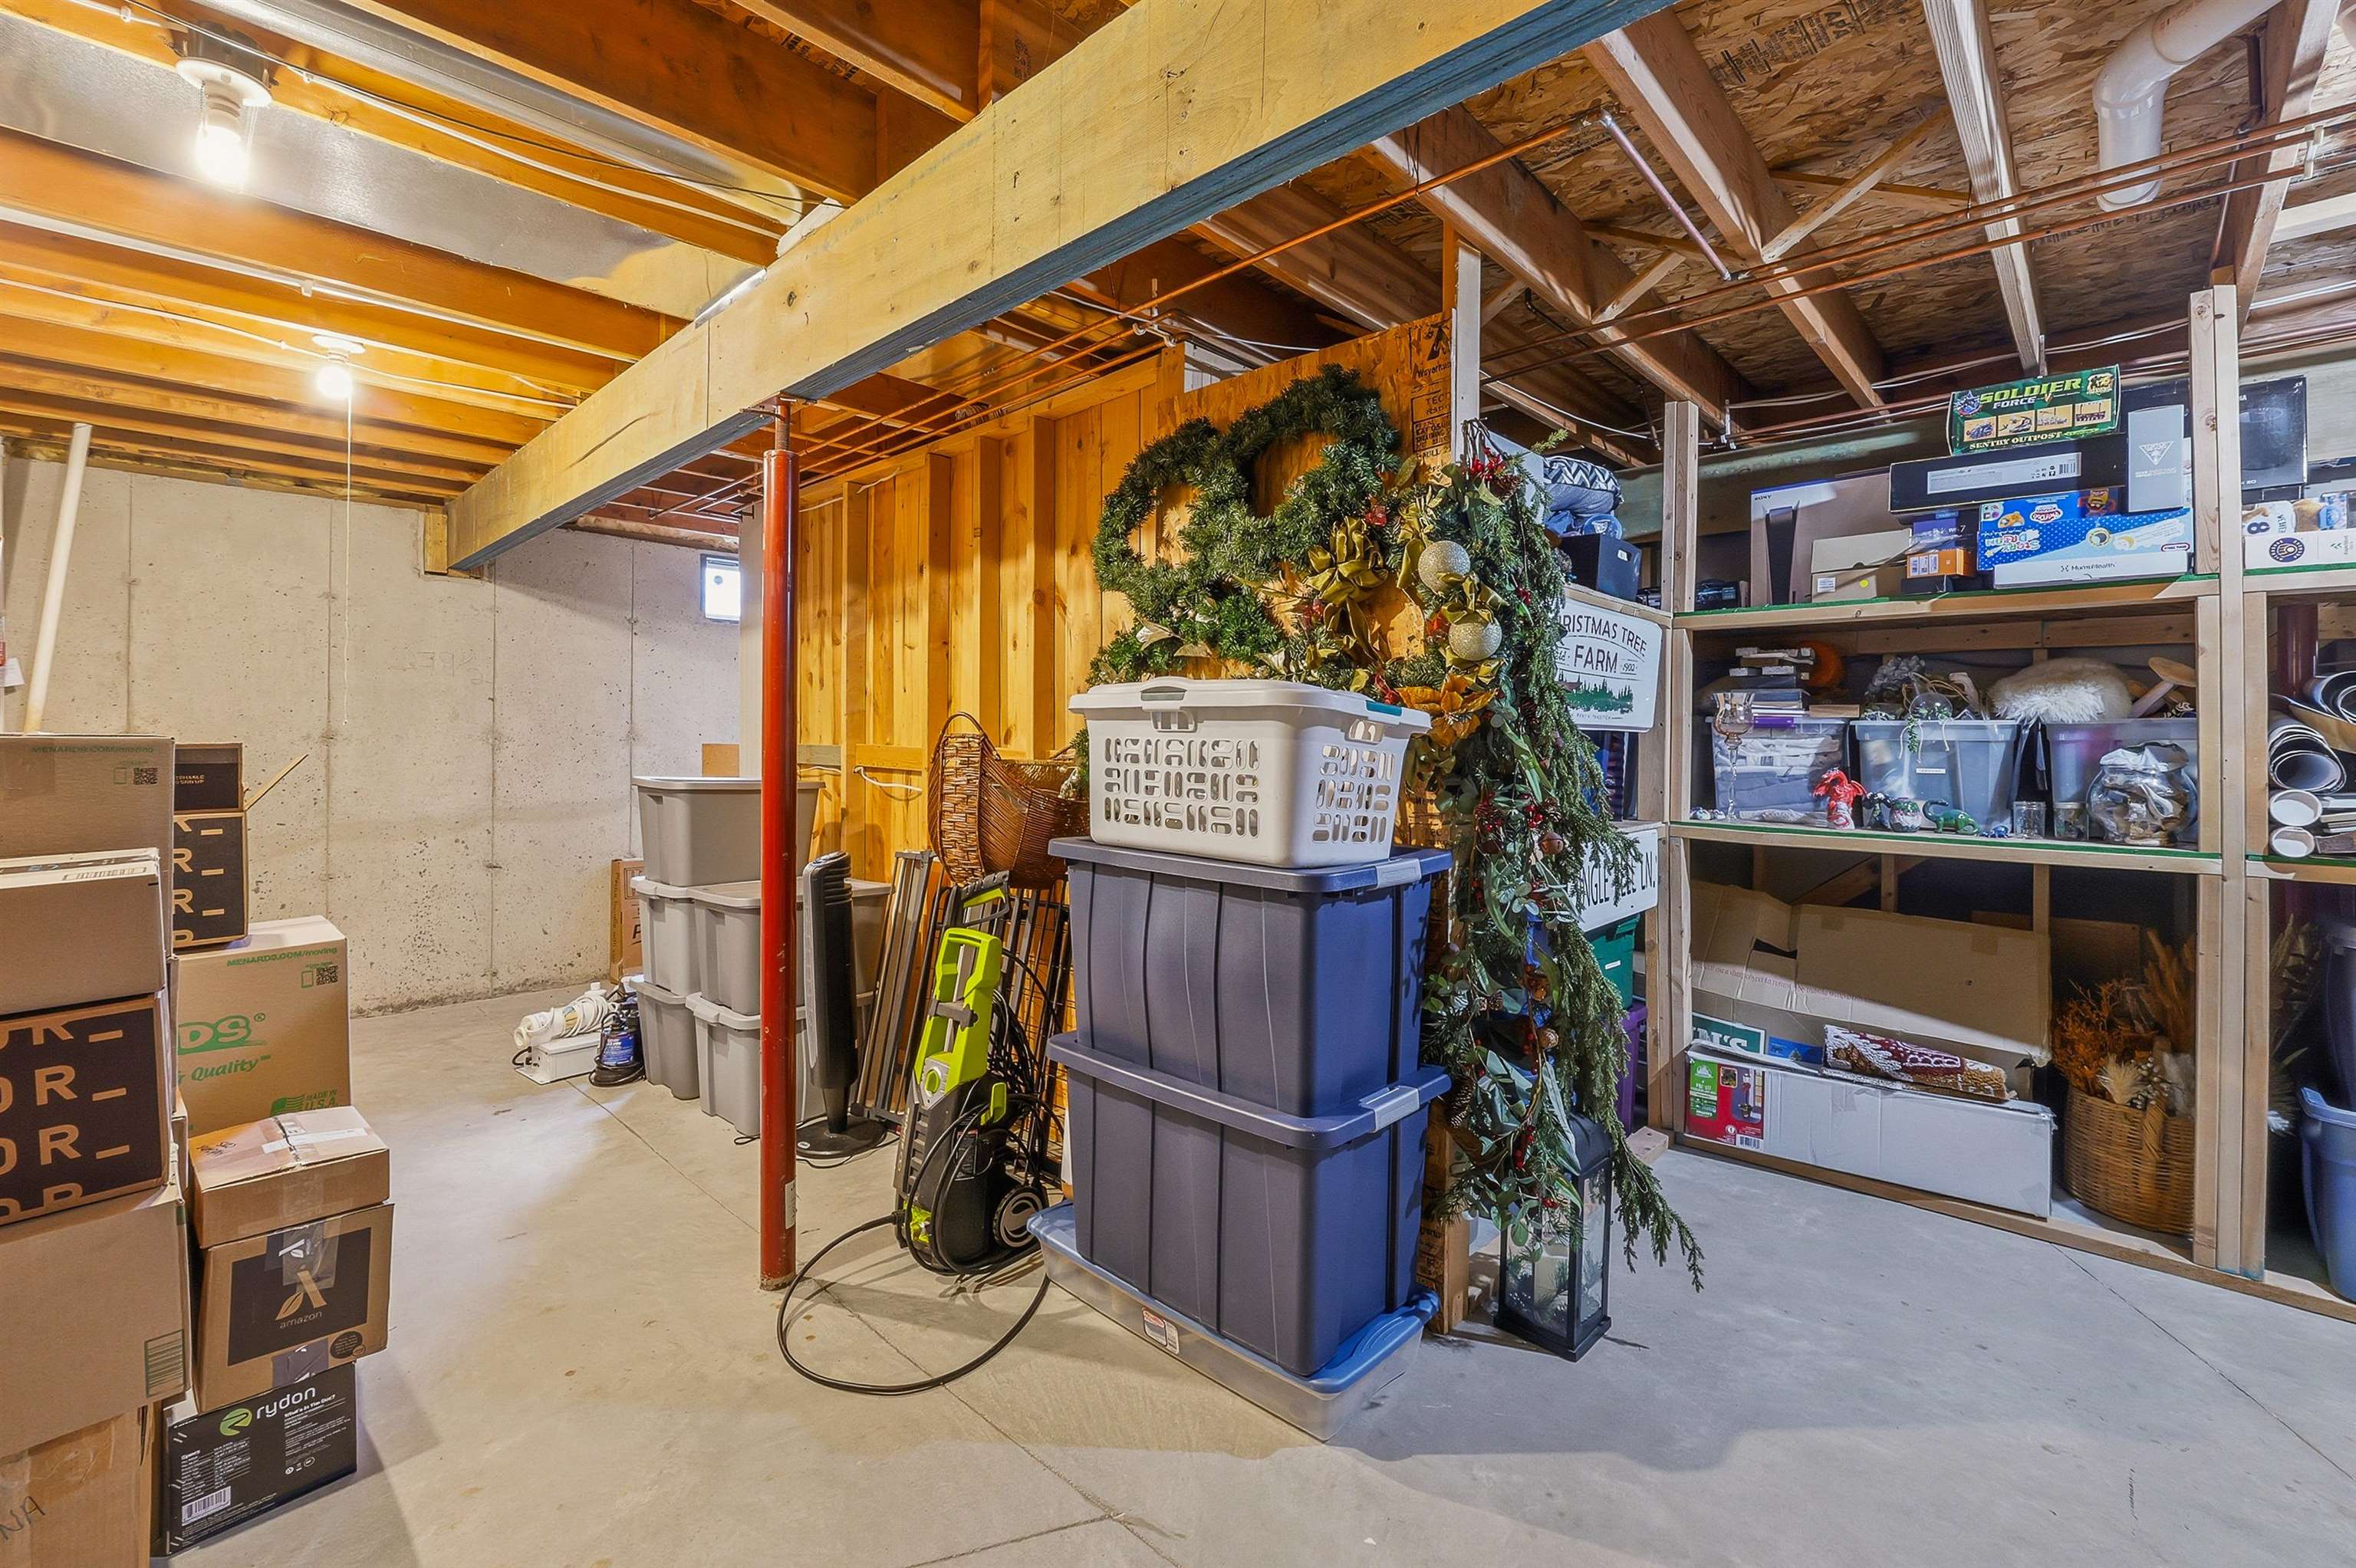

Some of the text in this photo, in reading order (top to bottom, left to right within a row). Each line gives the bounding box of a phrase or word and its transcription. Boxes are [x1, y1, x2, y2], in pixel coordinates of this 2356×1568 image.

[1979, 378, 2081, 404] SOLDIER
[1992, 396, 2037, 409] FORCE
[1969, 431, 2063, 450] SENTRY OUTPOST
[1559, 614, 1647, 657] RISTMAS TREE
[1574, 644, 1618, 673] FARM
[1581, 861, 1610, 906] NGLE
[227, 947, 337, 966] MENARDS.COM/moving
[279, 1311, 322, 1329] amazon
[256, 1387, 316, 1420] rydon
